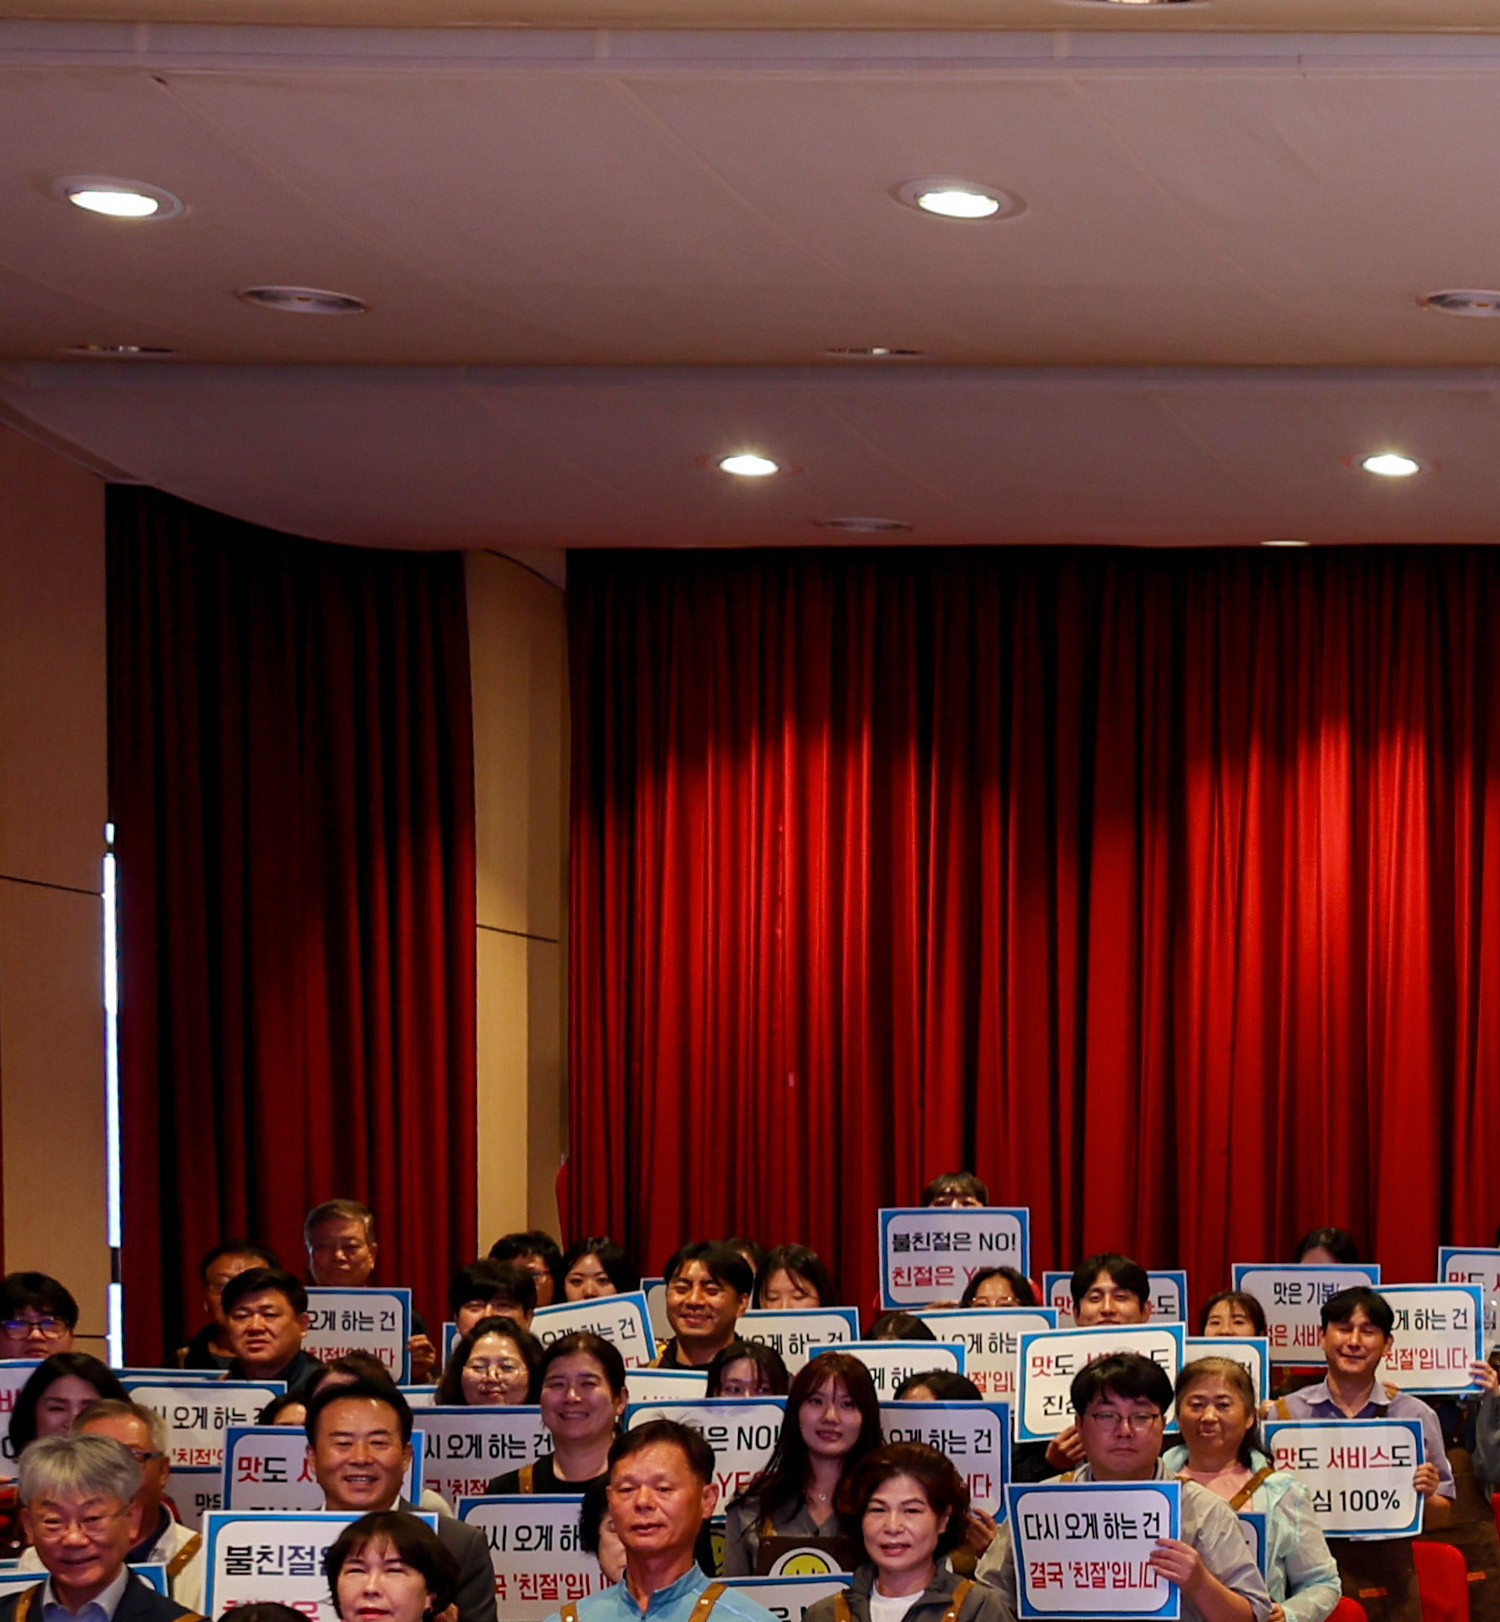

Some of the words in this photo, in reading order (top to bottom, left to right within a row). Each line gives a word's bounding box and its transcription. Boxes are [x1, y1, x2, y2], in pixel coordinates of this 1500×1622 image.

[892, 1232, 971, 1253] 불친절은
[979, 1233, 1015, 1251] NO!
[893, 1266, 954, 1287] 친절은
[446, 1434, 482, 1459] 오게
[488, 1434, 526, 1458] 하는
[1275, 1450, 1318, 1471] 맛도
[1327, 1445, 1412, 1469] 서비스도
[238, 1457, 288, 1482] 맛도
[1339, 1490, 1400, 1512] 100%
[513, 1525, 553, 1551] 오게
[1024, 1513, 1059, 1540] 다시
[1065, 1513, 1098, 1539] 오게
[1103, 1513, 1137, 1539] 하는
[1143, 1512, 1160, 1538] 건
[1030, 1562, 1063, 1588] 결국
